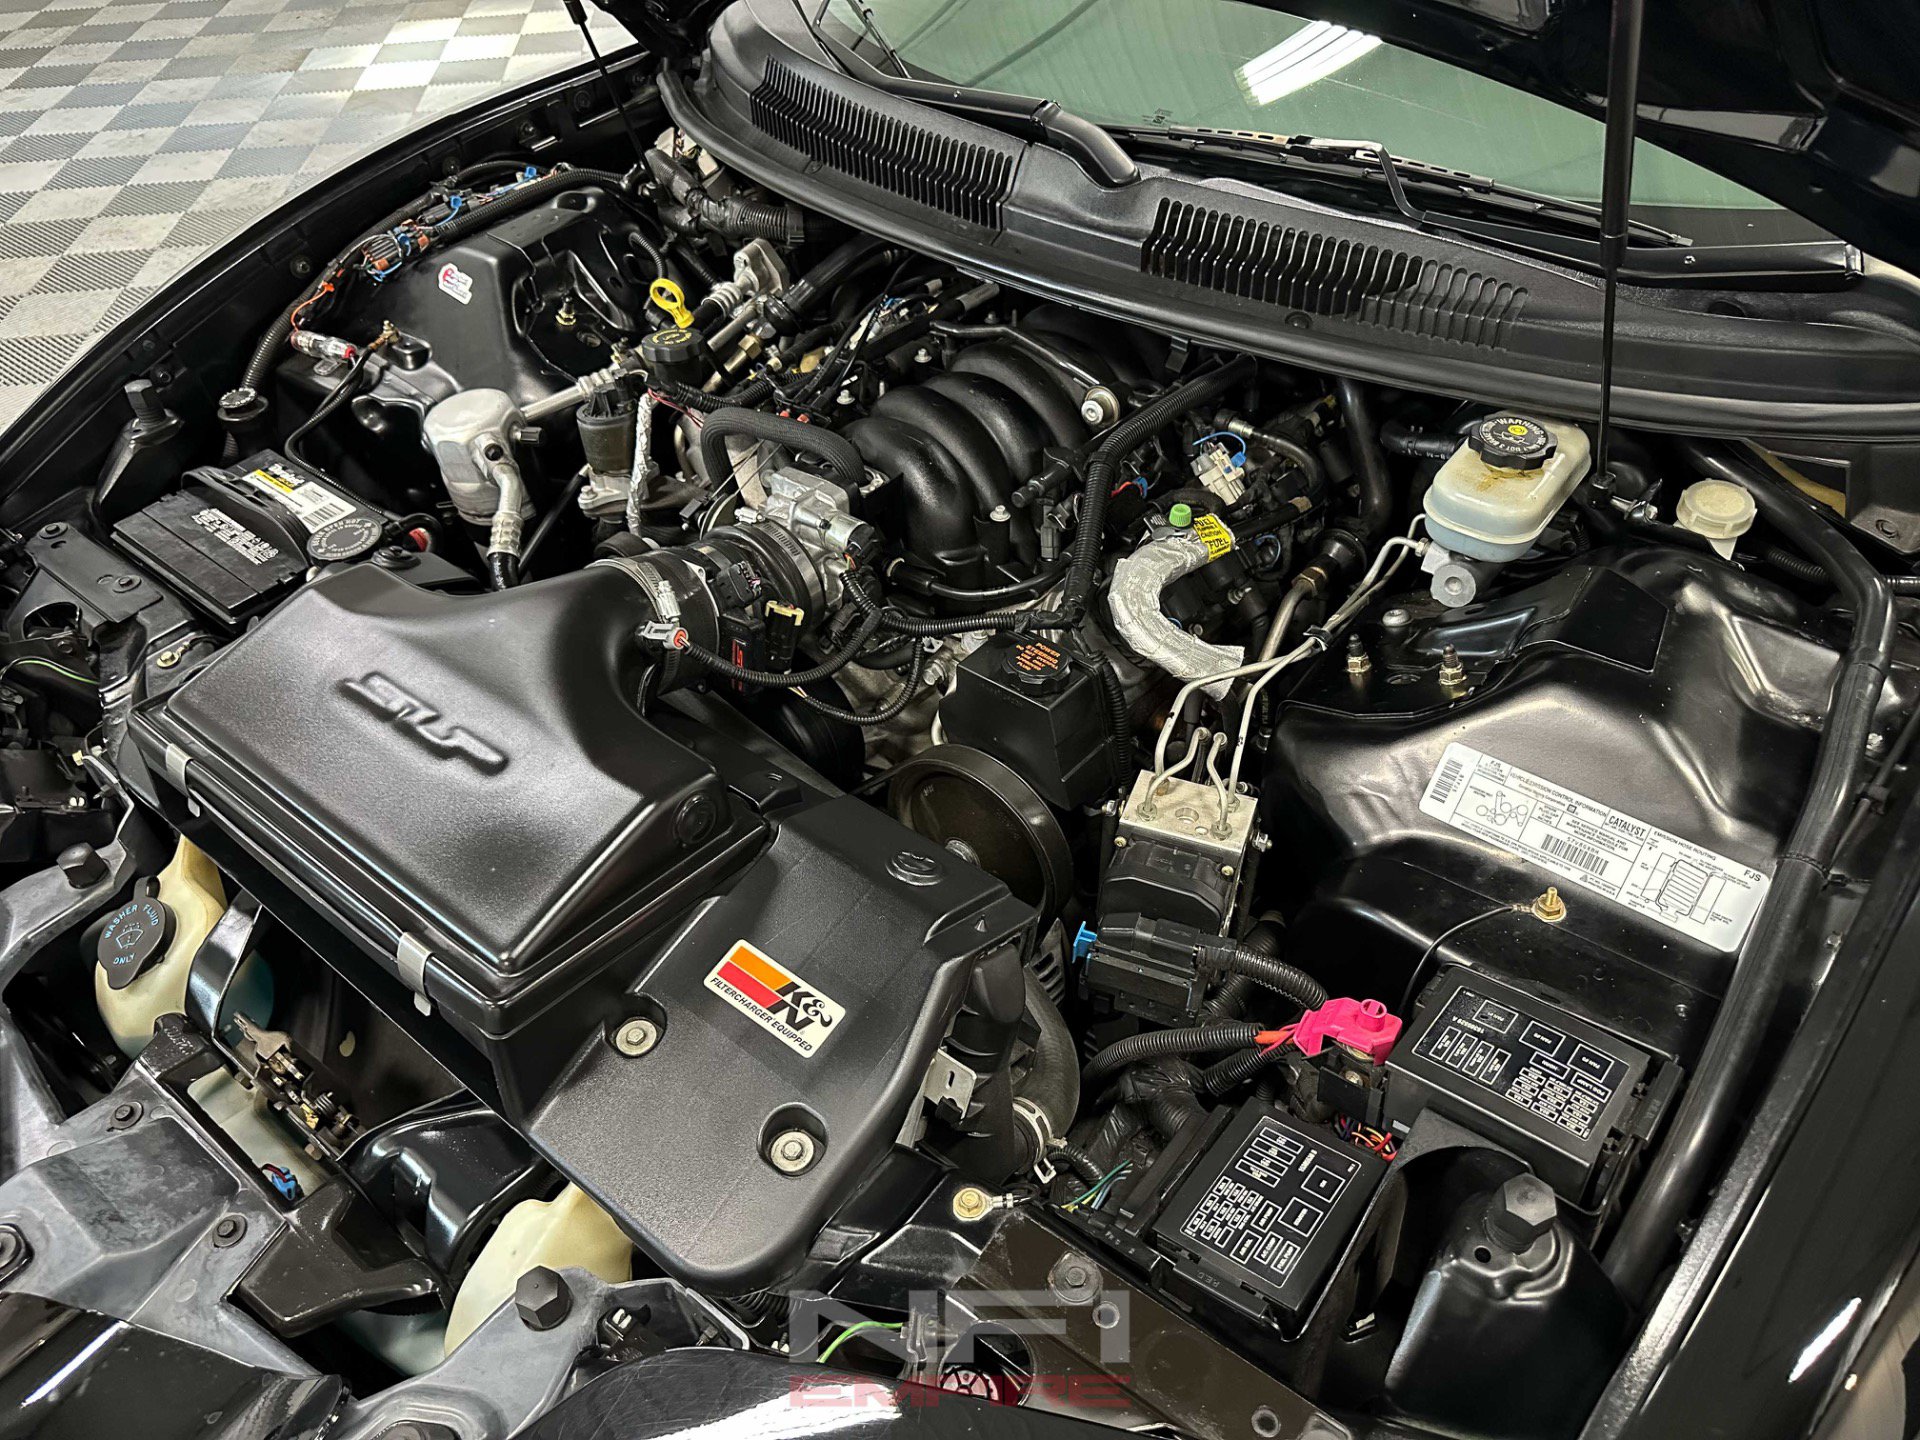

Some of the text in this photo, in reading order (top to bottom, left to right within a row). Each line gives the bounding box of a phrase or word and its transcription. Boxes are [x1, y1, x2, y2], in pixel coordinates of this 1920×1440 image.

[1497, 418, 1544, 434] WARNING
[1209, 537, 1229, 550] FUEL
[1026, 645, 1058, 664] STEERING
[1035, 642, 1061, 658] POWER
[1552, 790, 1574, 804] CONTROL
[1575, 800, 1607, 818] INFORMATION
[1608, 815, 1646, 838] CATALYST
[1654, 831, 1679, 845] EMISSION
[1679, 841, 1693, 851] HOSE
[1692, 847, 1717, 862] ROUTING
[1743, 869, 1762, 883] FJS
[104, 904, 159, 939] WASHER FLUID
[113, 953, 135, 965] ONLY
[771, 1021, 813, 1052] EQUIPPED
[1589, 1060, 1601, 1069] FAN
[1576, 1078, 1605, 1096] FOG LAMP
[1258, 1217, 1266, 1227] AIR
[1239, 1246, 1247, 1256] AIR
[1277, 1245, 1294, 1270] FUEL PUMP
